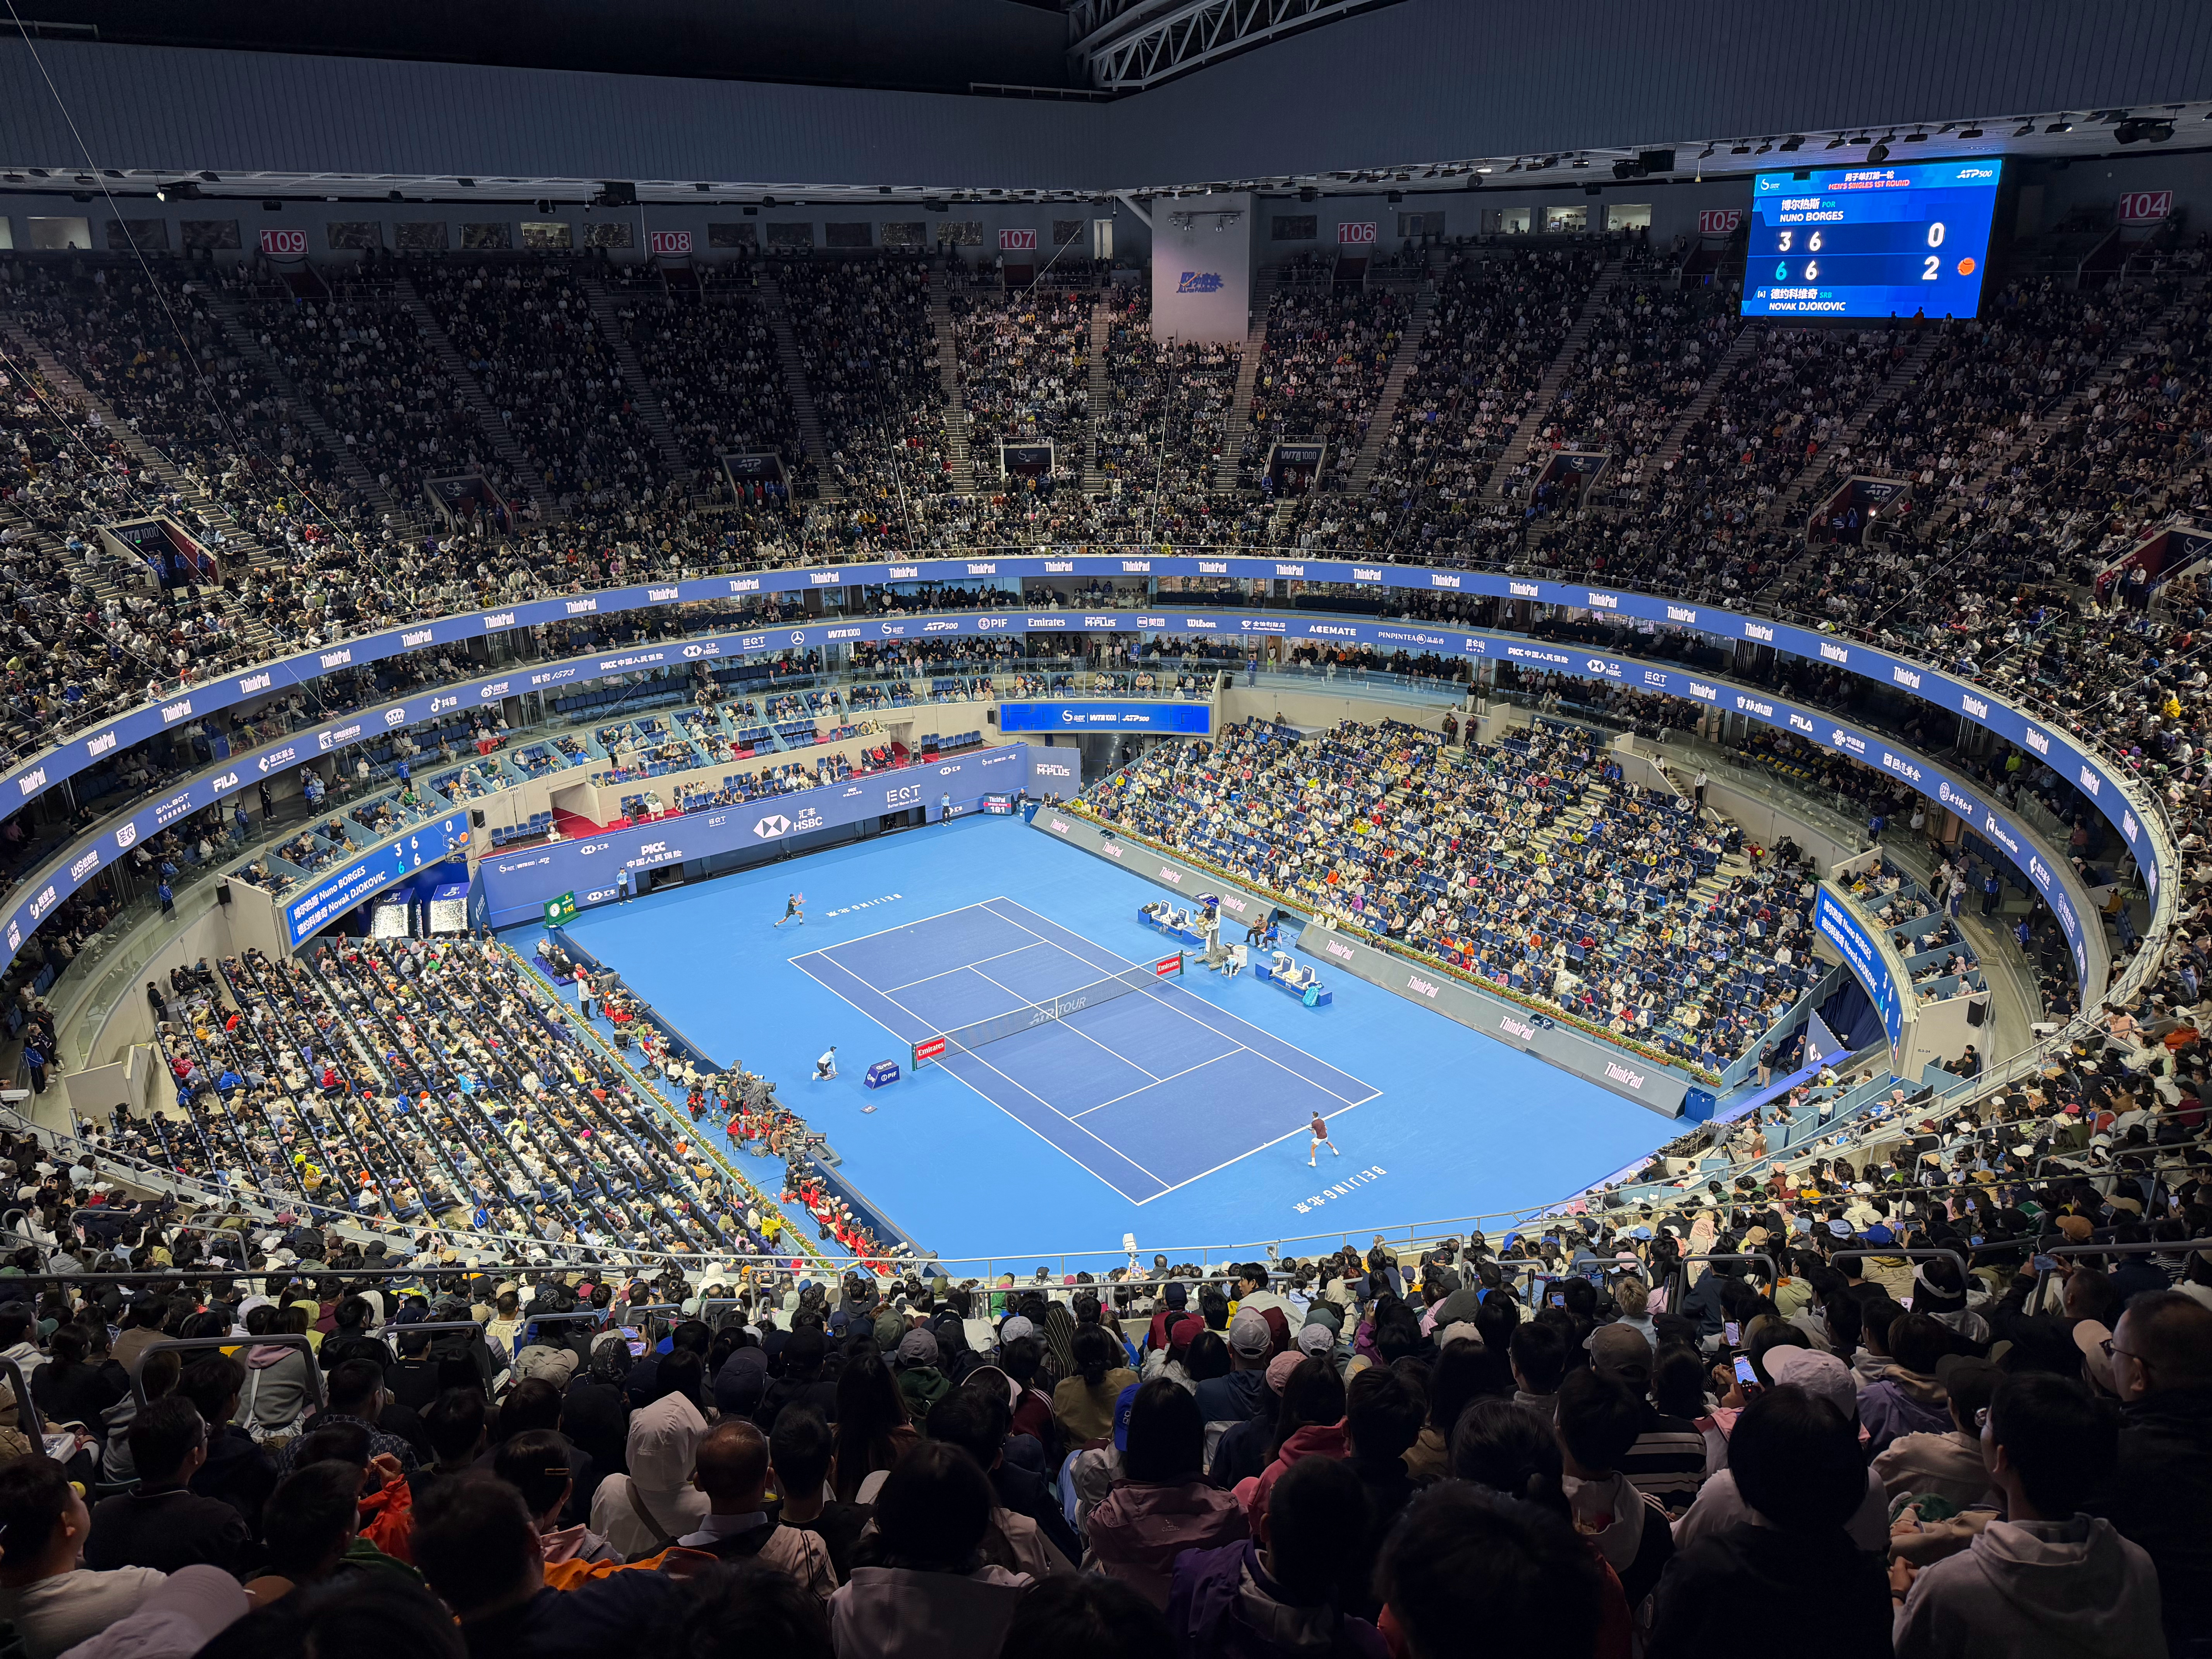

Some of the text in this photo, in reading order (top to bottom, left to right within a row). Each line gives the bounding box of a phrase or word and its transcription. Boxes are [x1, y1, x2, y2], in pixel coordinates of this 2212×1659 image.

[1844, 170, 1895, 182] 男子单打第一轮
[1781, 198, 1820, 211] 博尔热斯
[2122, 192, 2167, 218] 104
[1701, 211, 1739, 231] 105
[1780, 211, 1844, 222] NUNO BORGES
[1001, 231, 1034, 247] 107
[1340, 224, 1374, 242] 106
[1779, 222, 1945, 251] 3 6 0
[263, 232, 305, 252] 109
[653, 233, 690, 251] 108
[1776, 256, 1940, 280] 6 6 2
[1771, 288, 1817, 299] 德约科维奇
[1769, 302, 1846, 311] NOVAK DJOKOVIC
[737, 459, 761, 468] ATP
[1863, 484, 1892, 496] ATP
[888, 567, 918, 578] ThinkPad
[967, 563, 996, 574] ThinkPad
[1044, 561, 1073, 572] ThinkPad
[1121, 561, 1150, 572] ThinkPad
[1199, 562, 1227, 573] ThinkPad
[1276, 564, 1304, 576] ThinkPad
[1353, 568, 1381, 580] ThinkPad
[729, 578, 759, 592] ThinkPad
[809, 571, 839, 584] ThinkPad
[1431, 574, 1460, 587] ThinkPad
[647, 587, 678, 601] ThinkPad
[1510, 582, 1538, 597] ThinkPad
[565, 598, 597, 613] ThinkPad
[1589, 592, 1618, 608] ThinkPad
[483, 612, 515, 629] ThinkPad
[991, 618, 1008, 628] PIF
[1028, 618, 1065, 627] Emirates
[1149, 618, 1164, 627] 美团
[1667, 606, 1696, 623] ThinkPad
[1187, 619, 1217, 628] Wilson
[1309, 625, 1357, 636] ACEMATE
[1745, 622, 1773, 641] ThinkPad
[401, 629, 433, 647] ThinkPad
[743, 636, 765, 646] EQT
[1378, 632, 1415, 641] PINPINTEA
[1466, 639, 1485, 650] 昆仑山
[320, 649, 351, 668] ThinkPad
[1508, 647, 1569, 664] PICC 中国人民保险
[1820, 642, 1848, 663] ThinkPad
[601, 653, 663, 670] PICC 中国人民保险
[1606, 669, 1621, 677] HSBC
[1645, 671, 1667, 683] EQT
[1894, 666, 1920, 689] ThinkPad
[239, 672, 271, 694] ThinkPad
[493, 682, 508, 692] 微博
[1690, 682, 1716, 700] ThinkPad
[441, 696, 457, 708] 抖音
[1962, 694, 1988, 719] ThinkPad
[161, 699, 192, 723] ThinkPad
[1790, 714, 1813, 732] FILA
[87, 731, 117, 757] ThinkPad
[2026, 727, 2049, 755] ThinkPad
[19, 767, 46, 795] ThinkPad
[213, 772, 238, 792] FILA
[886, 784, 921, 802] EQT
[156, 793, 189, 814] GALBOT
[1949, 793, 1972, 814] 北京同仁堂
[709, 816, 726, 824] EQT
[799, 807, 816, 819] 汇丰
[793, 816, 823, 831] HSBC
[1050, 818, 1070, 834] ThinkPad
[118, 825, 134, 844] 圣农
[1994, 826, 2018, 853] luckin coffee
[641, 841, 666, 855] PICC
[1102, 842, 1124, 858] ThinkPad
[627, 850, 682, 868] 中国人民保险
[294, 820, 453, 920] 博尔热斯 Nuno BORGES 3 6 0
[1159, 866, 1182, 884] ThinkPad
[297, 853, 421, 936] 德约科维奇 Novak DJOKOVIC 6 6
[852, 893, 902, 910] BEIJING
[1221, 894, 1247, 912] ThinkPad
[563, 904, 574, 914] 1:45
[1326, 939, 1355, 960] ThinkPad
[1158, 960, 1179, 972] Emirates
[1843, 918, 1855, 939] Nuno
[1855, 933, 1872, 961] BORGES
[1883, 972, 1888, 989] 3
[1888, 986, 1893, 1002] 6
[1406, 975, 1439, 999] ThinkPad
[1844, 941, 1858, 964] Novak
[1857, 957, 1877, 993] DJOKOVIC
[1880, 994, 1884, 1010] 6
[1885, 1008, 1889, 1024] 6
[1027, 997, 1086, 1025] ATP TOUR
[1499, 1015, 1535, 1041] ThinkPad
[918, 1042, 944, 1056] Emirates
[1604, 1061, 1645, 1089] ThinkPad
[1292, 1165, 1387, 1214] BEIJING 北京
